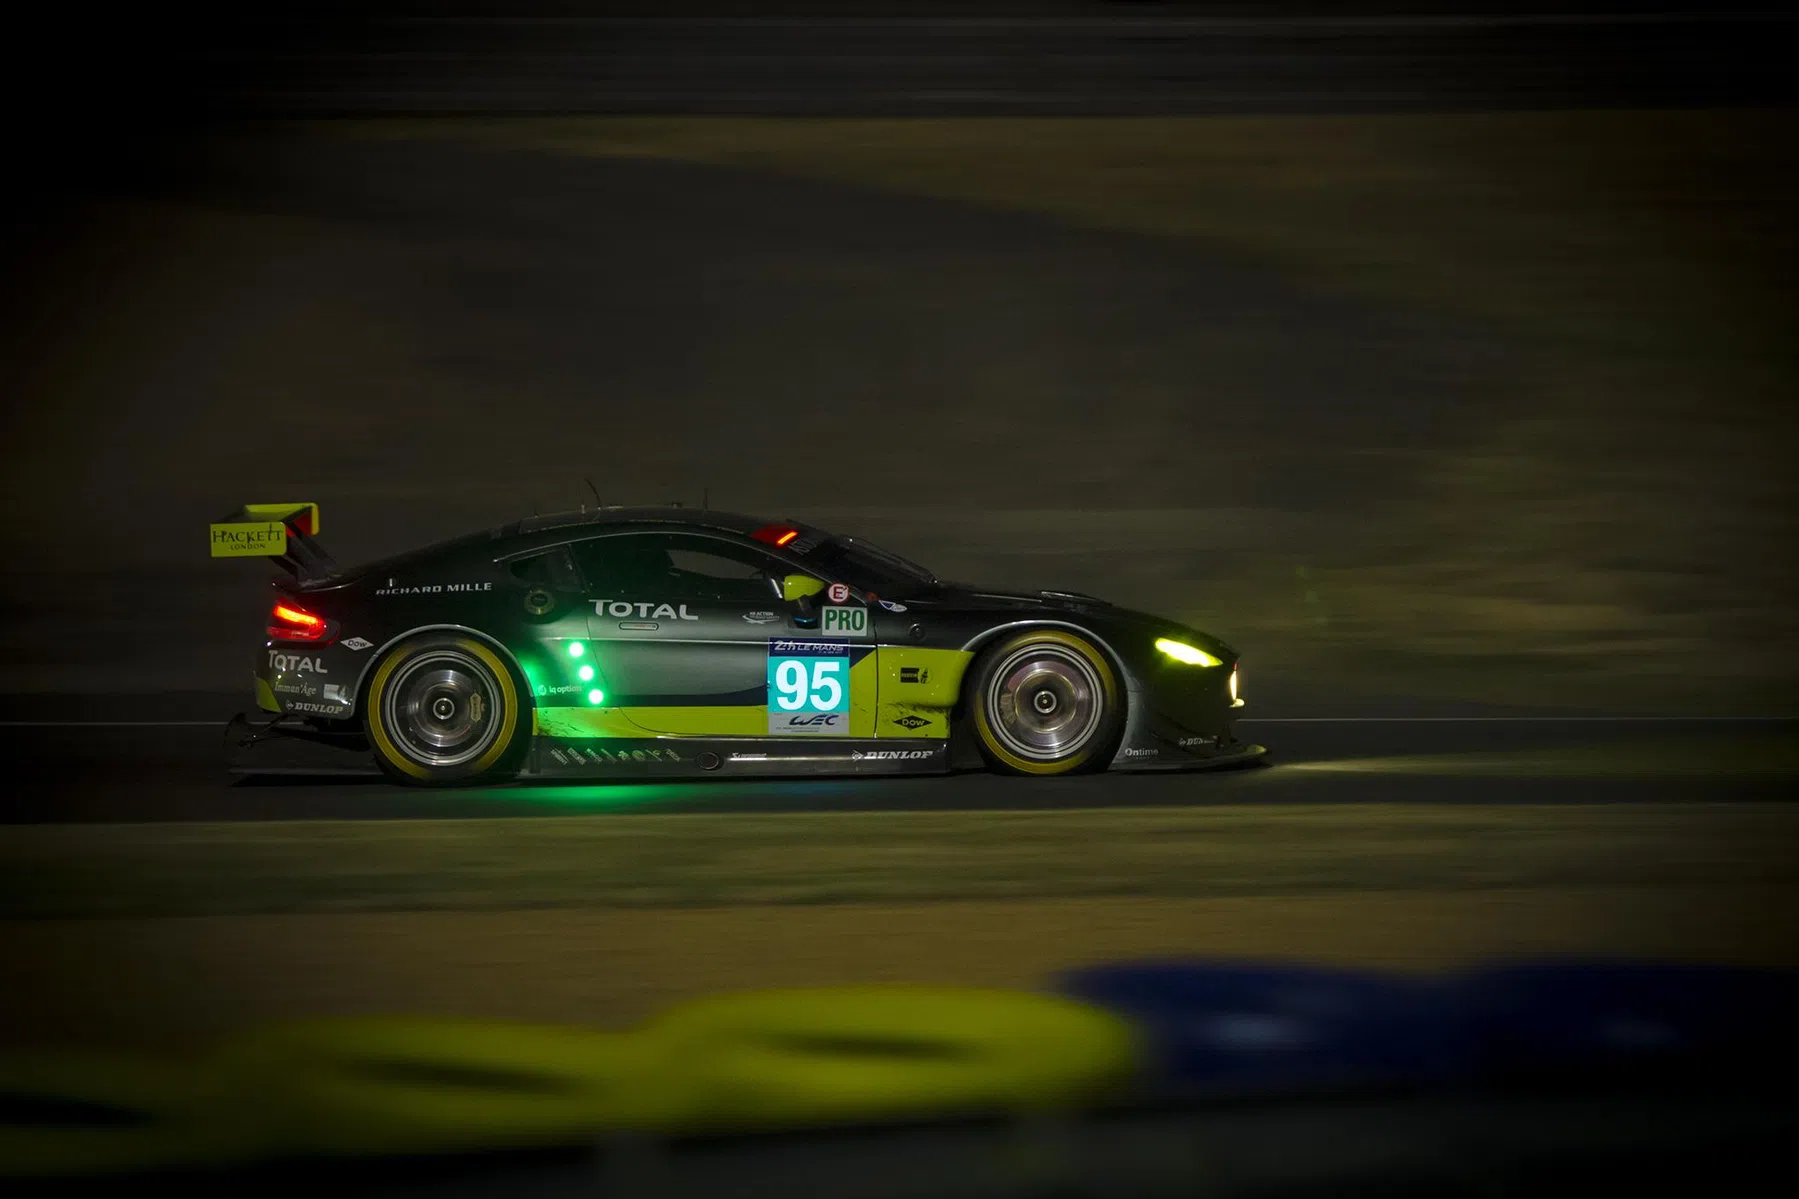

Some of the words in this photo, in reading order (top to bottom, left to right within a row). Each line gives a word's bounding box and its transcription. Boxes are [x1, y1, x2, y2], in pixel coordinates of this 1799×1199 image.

[211, 523, 283, 544] HACKETT
[376, 585, 442, 595] RICHARD
[447, 582, 492, 592] MILLE
[588, 599, 699, 621] TOTAL
[825, 610, 865, 631] PRO
[268, 649, 328, 674] TOTAL
[775, 660, 842, 711] 95
[294, 702, 344, 714] DUNLOP
[789, 714, 839, 726] WEC
[864, 750, 934, 760] DUNLOP
[1125, 748, 1159, 756] Ontime
